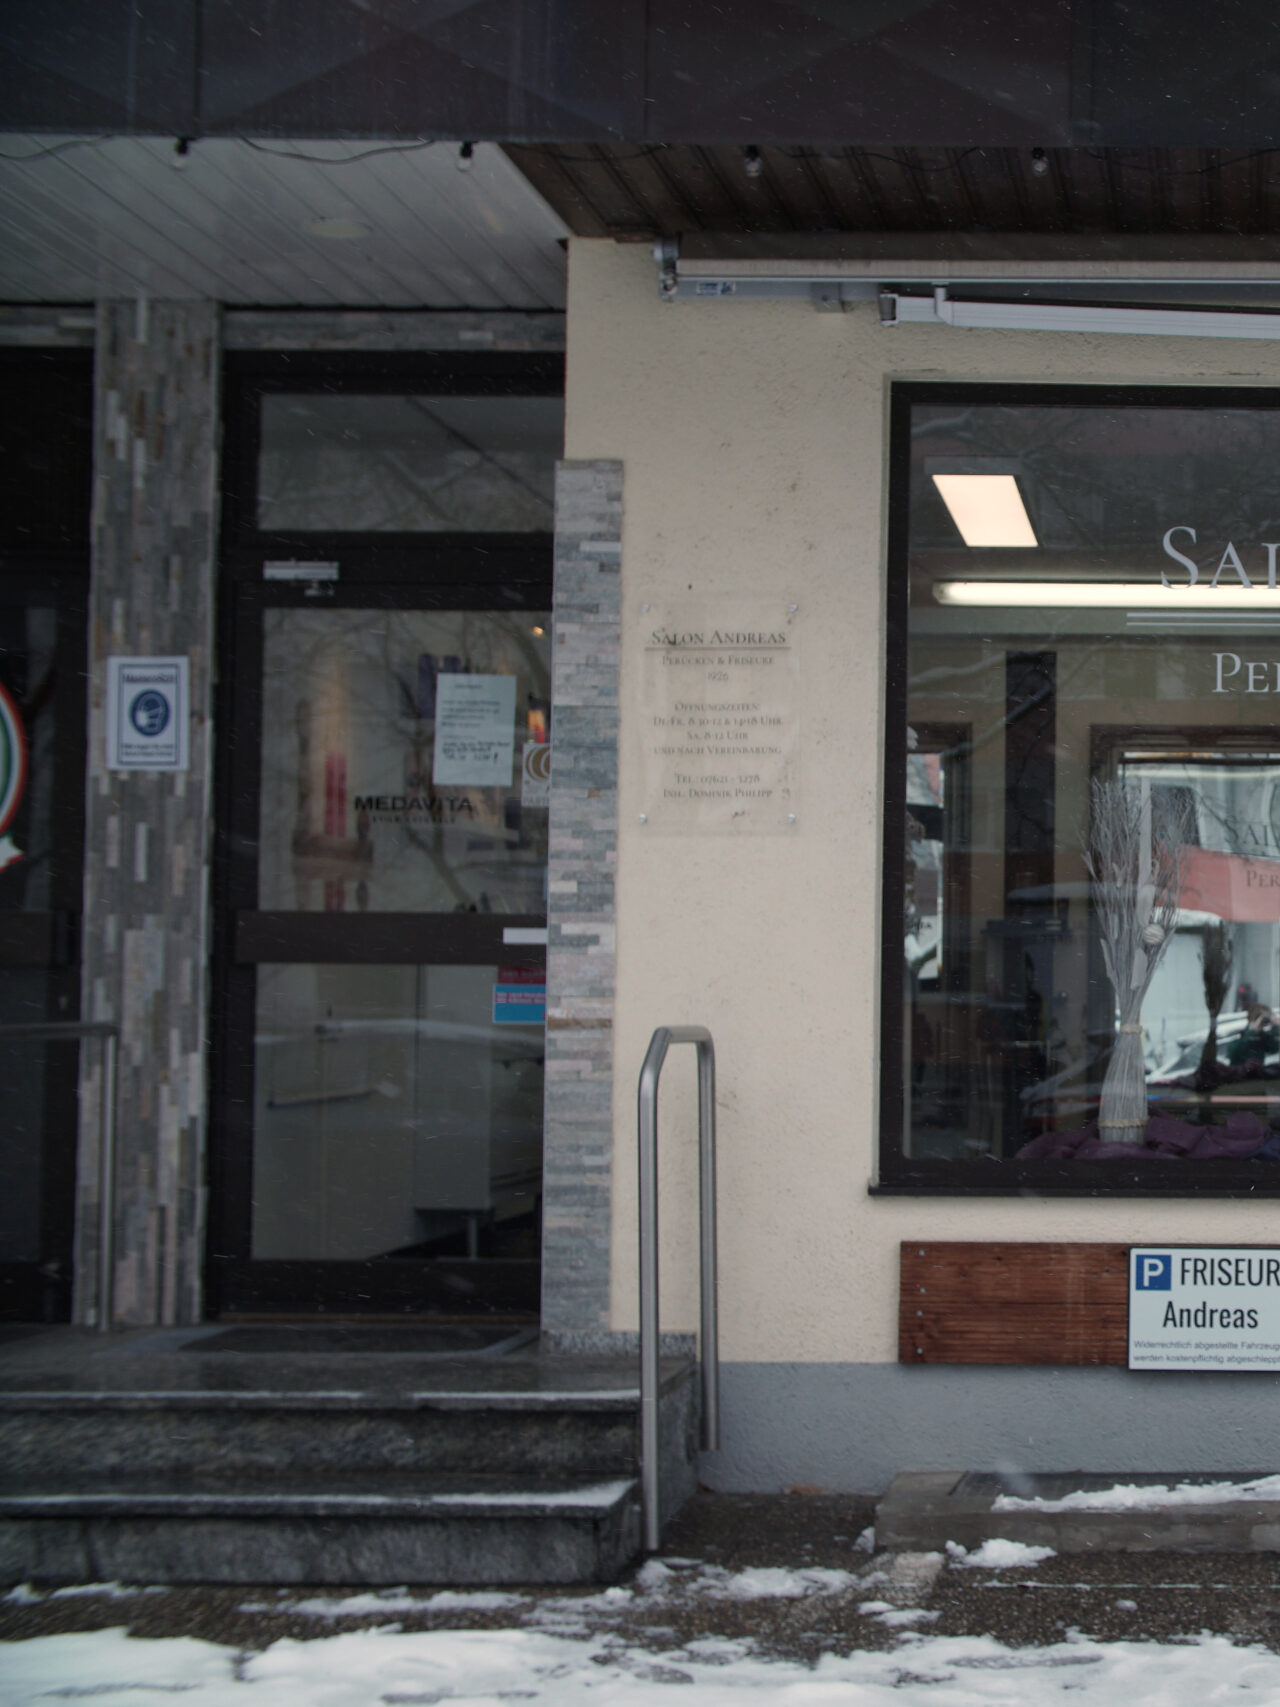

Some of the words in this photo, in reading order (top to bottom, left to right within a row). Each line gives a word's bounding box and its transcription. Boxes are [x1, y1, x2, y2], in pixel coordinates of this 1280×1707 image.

[651, 630, 704, 645] SALON
[710, 630, 786, 644] ANDREAS
[707, 672, 729, 682] 1926
[355, 796, 474, 811] MEDAVITA
[1143, 1258, 1164, 1287] P
[1180, 1257, 1280, 1287] FRISEUR
[1162, 1300, 1259, 1329] Andreas
